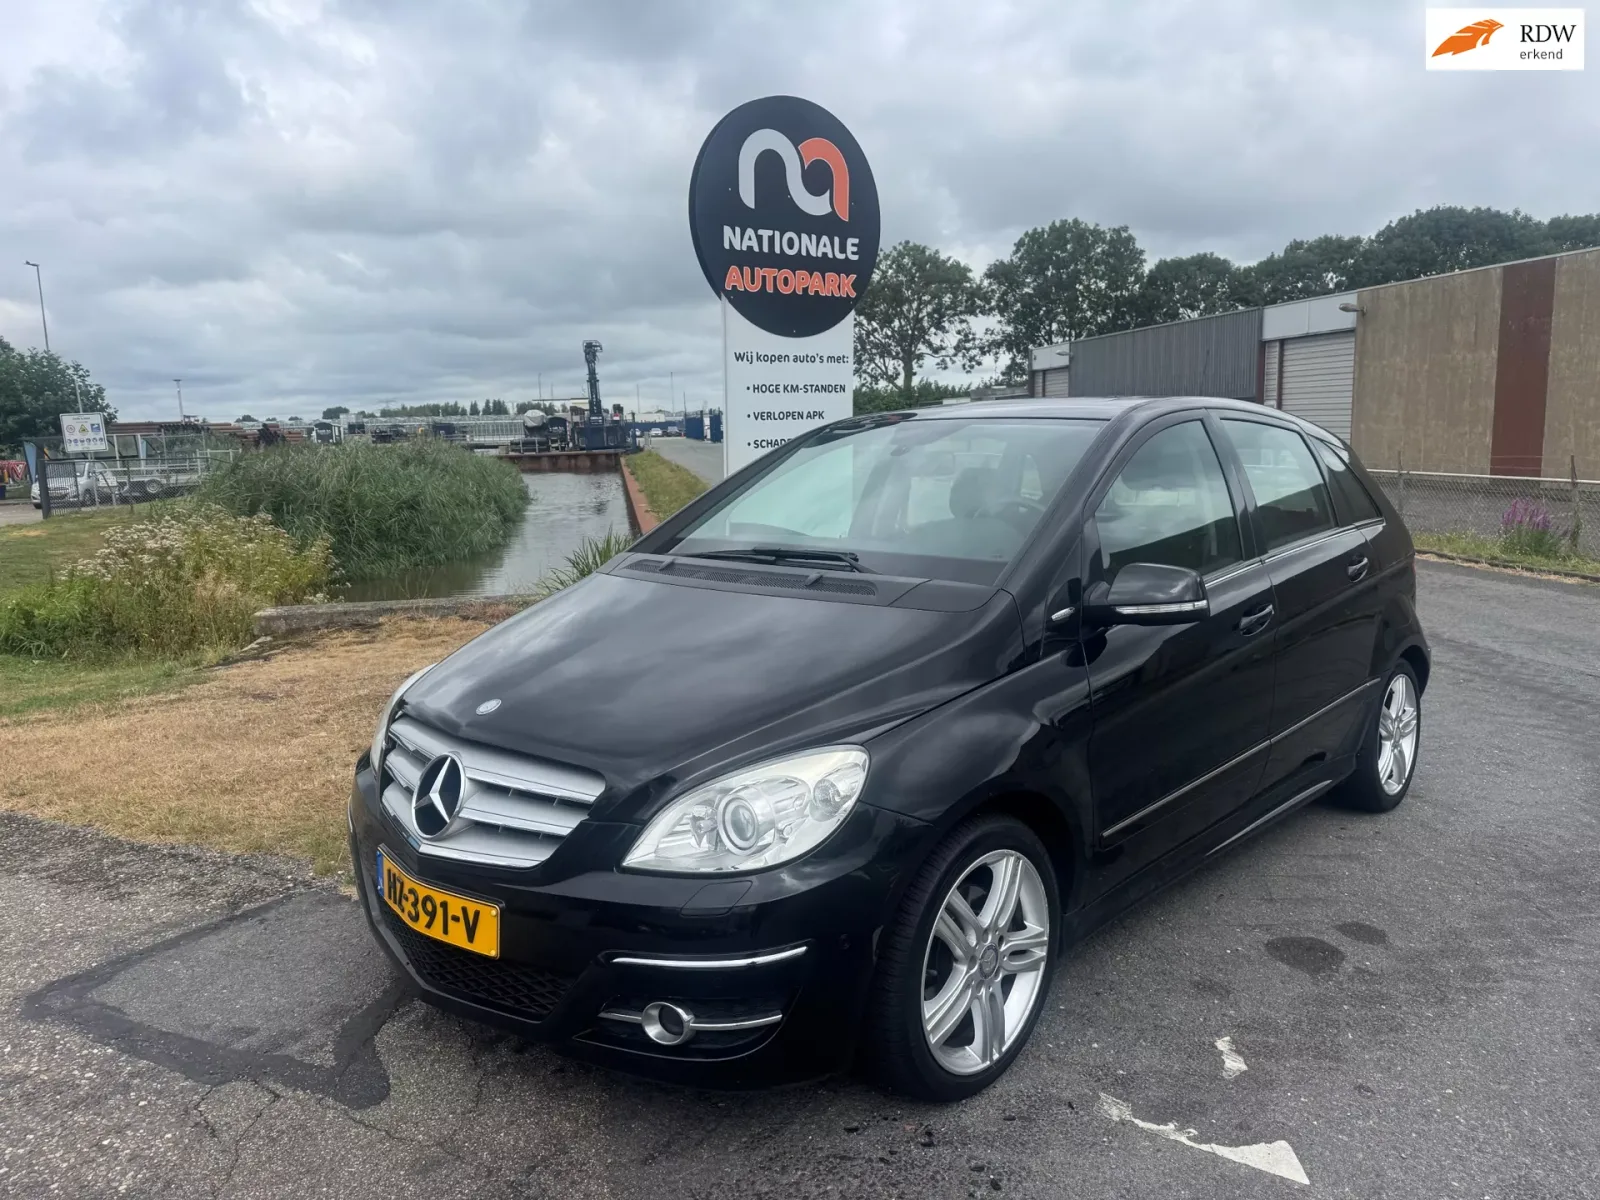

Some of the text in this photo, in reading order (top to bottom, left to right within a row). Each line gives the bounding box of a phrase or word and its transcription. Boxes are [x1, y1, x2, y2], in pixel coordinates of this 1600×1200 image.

[723, 225, 860, 261] NATIONALE
[724, 265, 857, 298] AUTOPARK
[734, 351, 849, 364] Wij kopen auto's met:
[752, 384, 846, 394] HOGE KM-STANDEN
[753, 410, 825, 421] VERLOPEN APK
[753, 438, 793, 449] SCHAD
[387, 868, 481, 944] HZ-391-V
